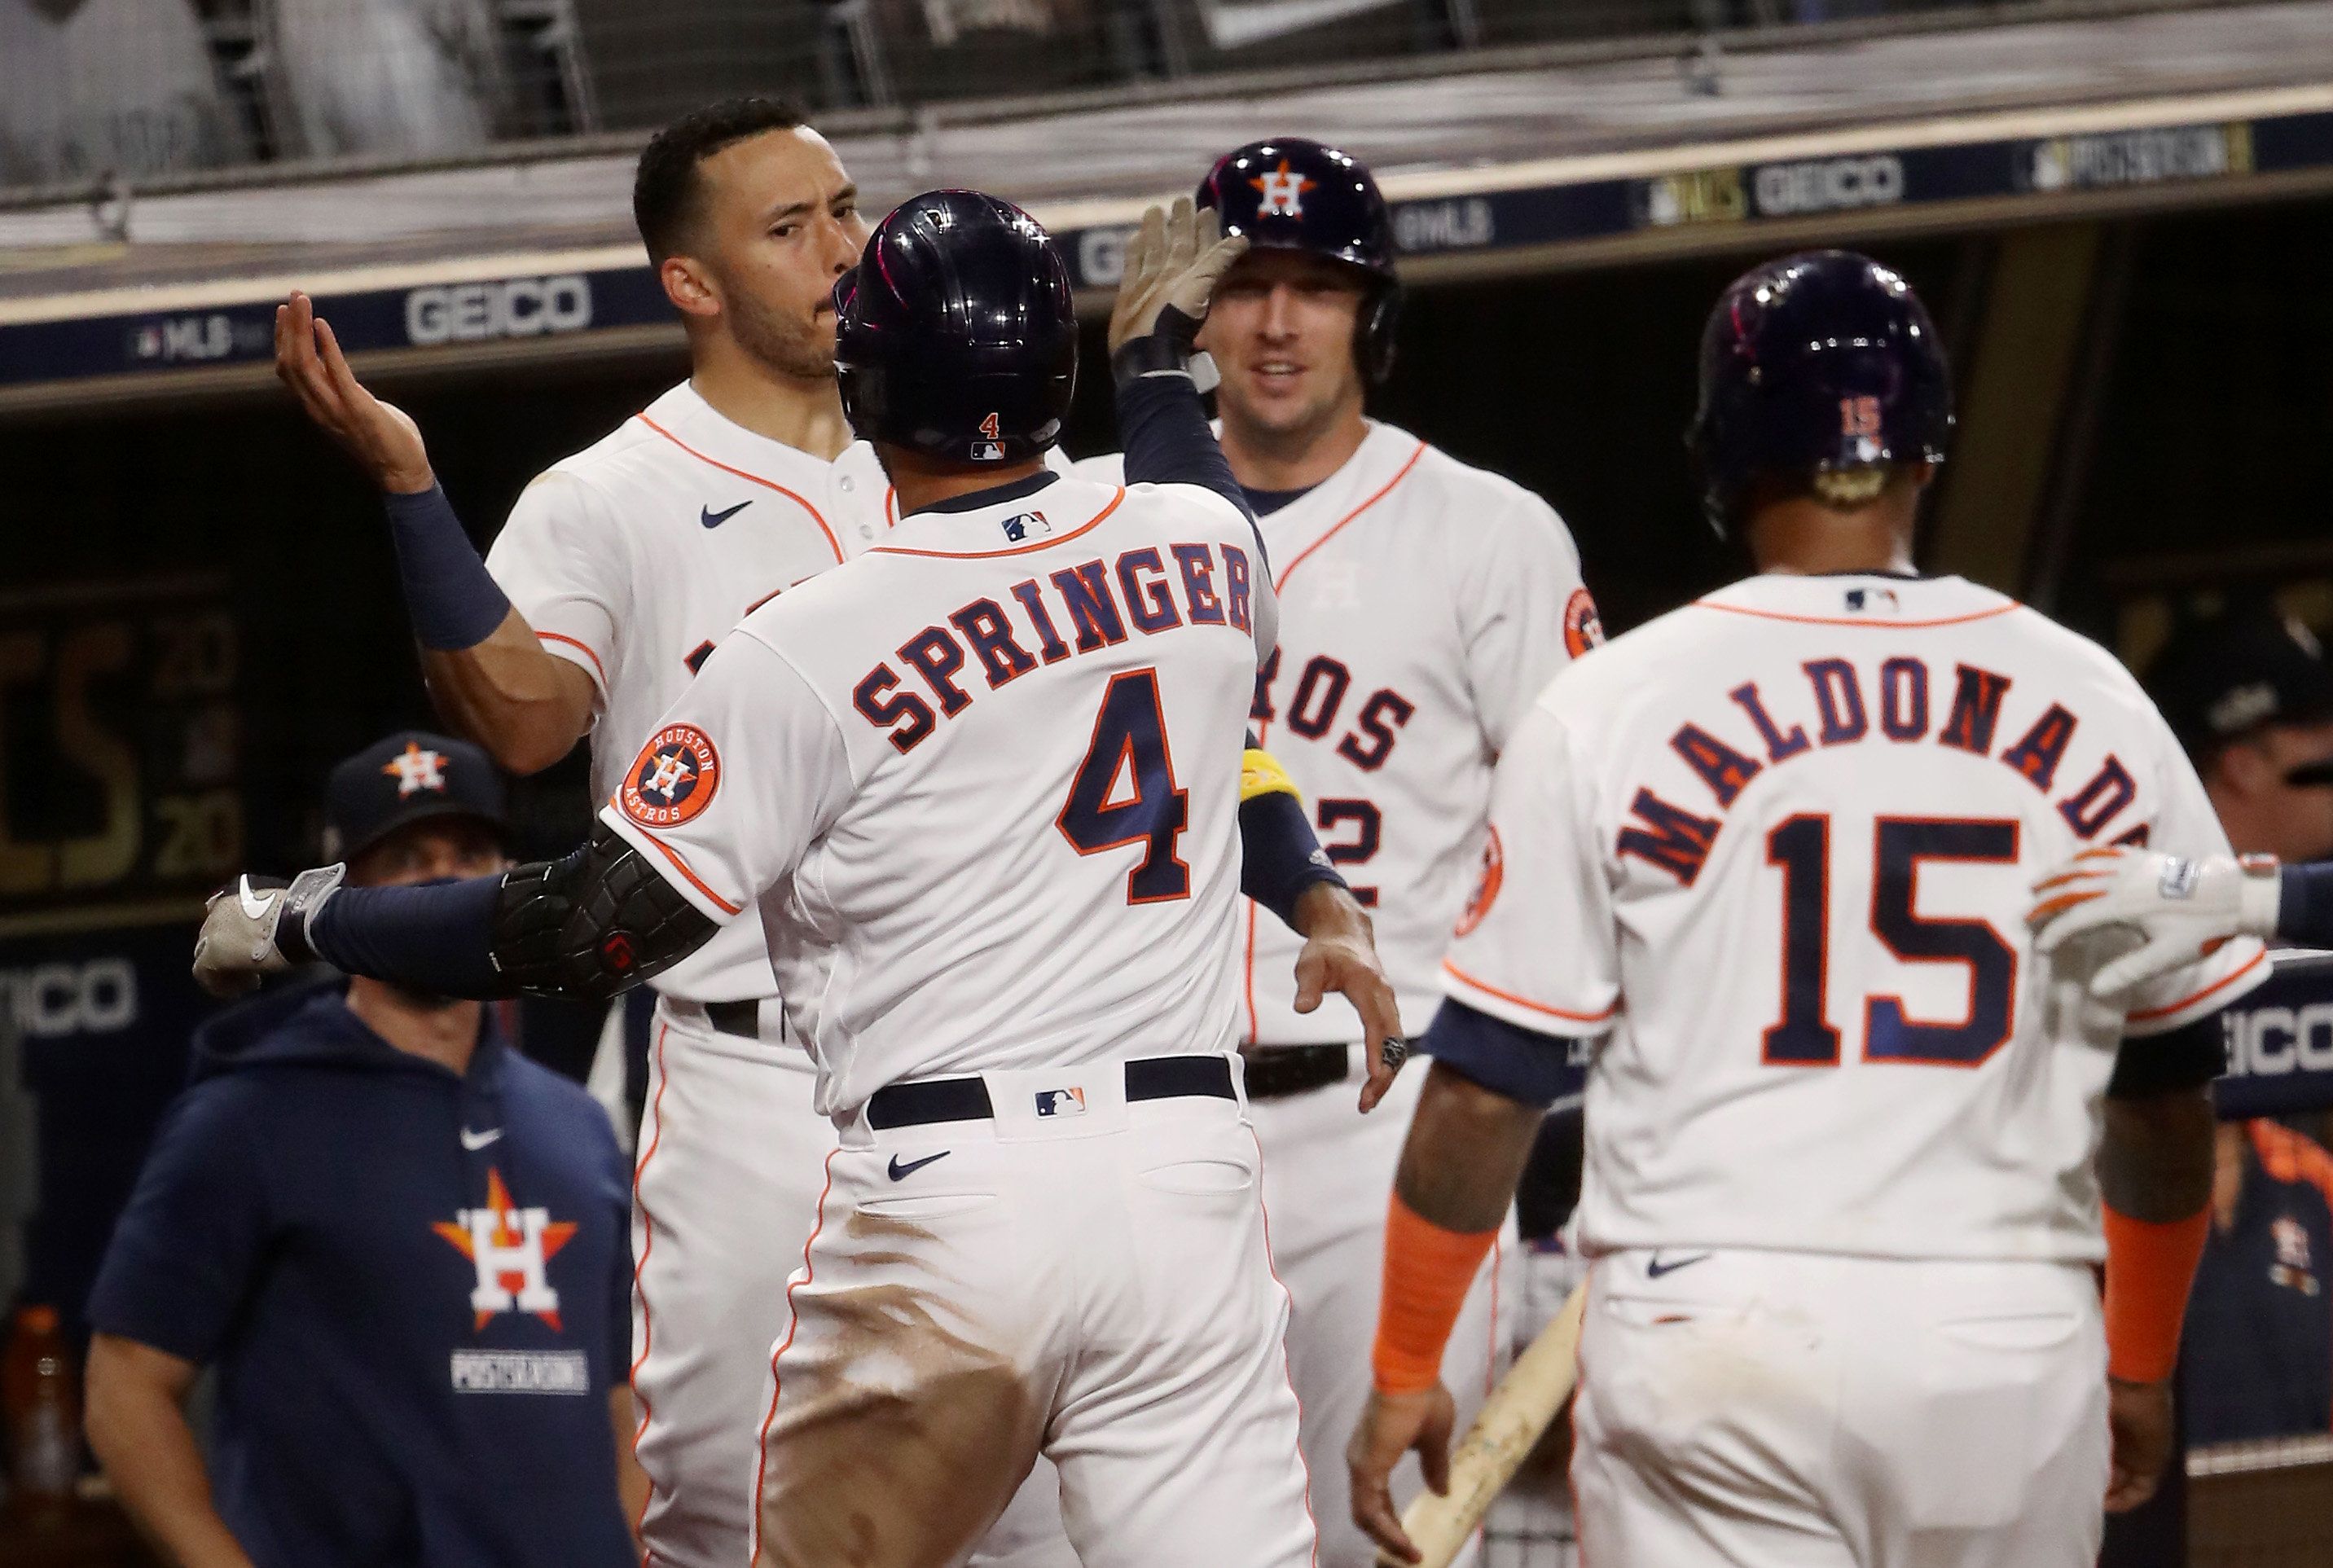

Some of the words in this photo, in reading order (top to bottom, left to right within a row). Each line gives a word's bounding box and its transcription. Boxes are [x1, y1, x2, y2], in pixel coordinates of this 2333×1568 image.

[1756, 157, 1903, 213] GEICO
[406, 278, 591, 344] GEICO
[979, 412, 1000, 439] 4
[852, 542, 1251, 755] SPRINGER
[654, 729, 714, 772] HOUSTON
[1054, 665, 1191, 906] 4
[626, 786, 681, 822] ASTROS
[1760, 813, 2020, 1069] 15
[0, 957, 138, 1037] ICO
[2223, 1004, 2333, 1078] ICO
